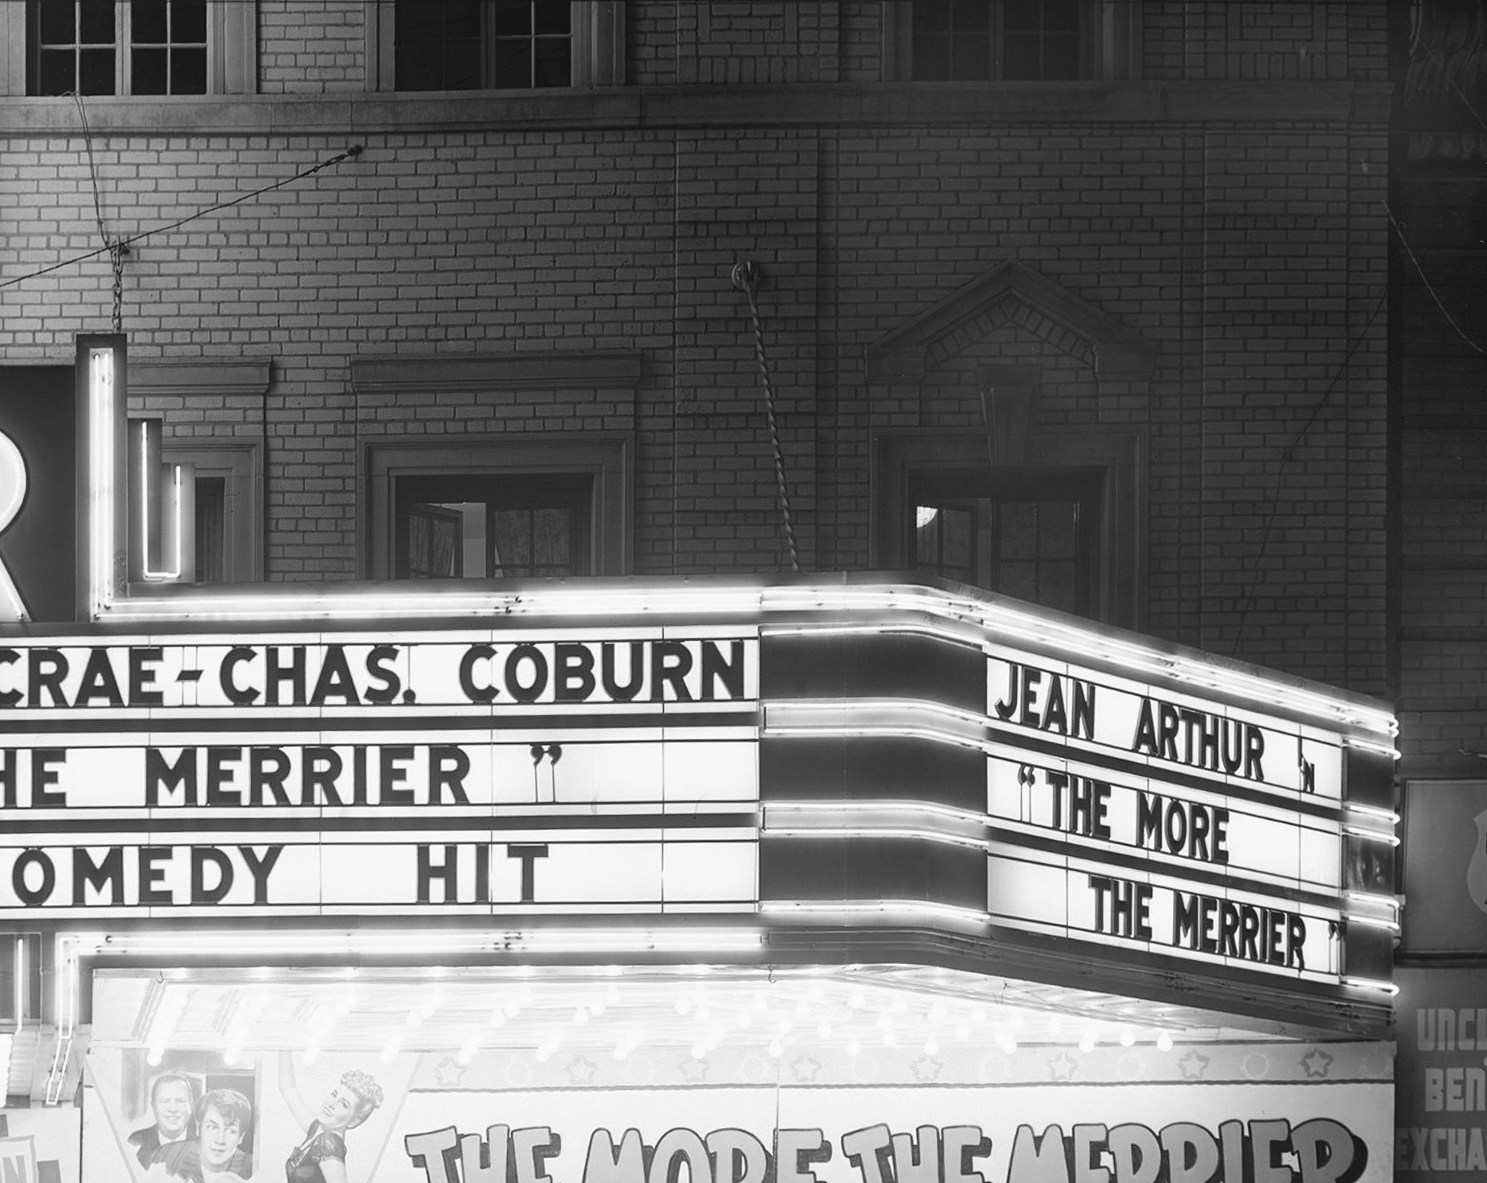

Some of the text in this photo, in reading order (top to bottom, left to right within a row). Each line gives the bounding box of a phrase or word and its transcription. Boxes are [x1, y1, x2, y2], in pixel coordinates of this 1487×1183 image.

[458, 640, 746, 704] COBURN
[994, 663, 1096, 742] JEAN
[1132, 696, 1265, 783] ARTHUR
[143, 745, 472, 808] MERRIER
[1136, 791, 1230, 865] MORE
[416, 842, 550, 905] HIT
[1088, 873, 1153, 942] THE
[1173, 890, 1307, 972] MERRIER
